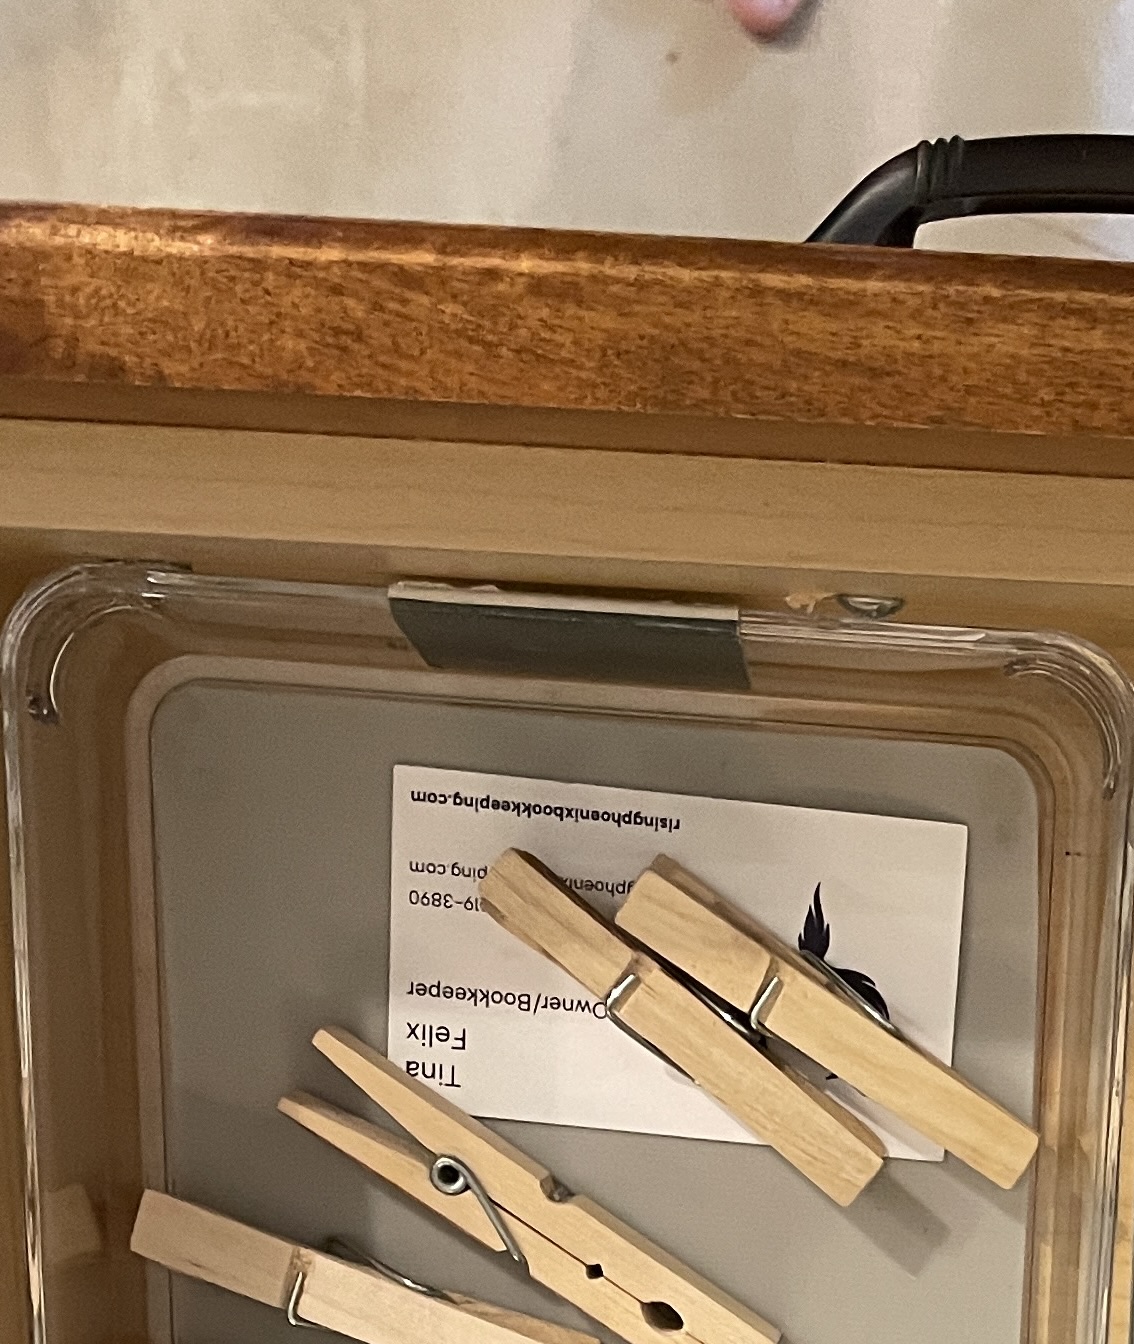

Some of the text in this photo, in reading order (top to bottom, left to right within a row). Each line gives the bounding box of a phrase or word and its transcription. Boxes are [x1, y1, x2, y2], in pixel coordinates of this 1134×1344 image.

[410, 791, 680, 833] risingphoenixbookkeeping.com
[409, 890, 479, 912] 19-3890
[406, 981, 607, 1020] Owner/Bookkeeper
[406, 1022, 466, 1051] Felix
[406, 1061, 461, 1088] Tina
